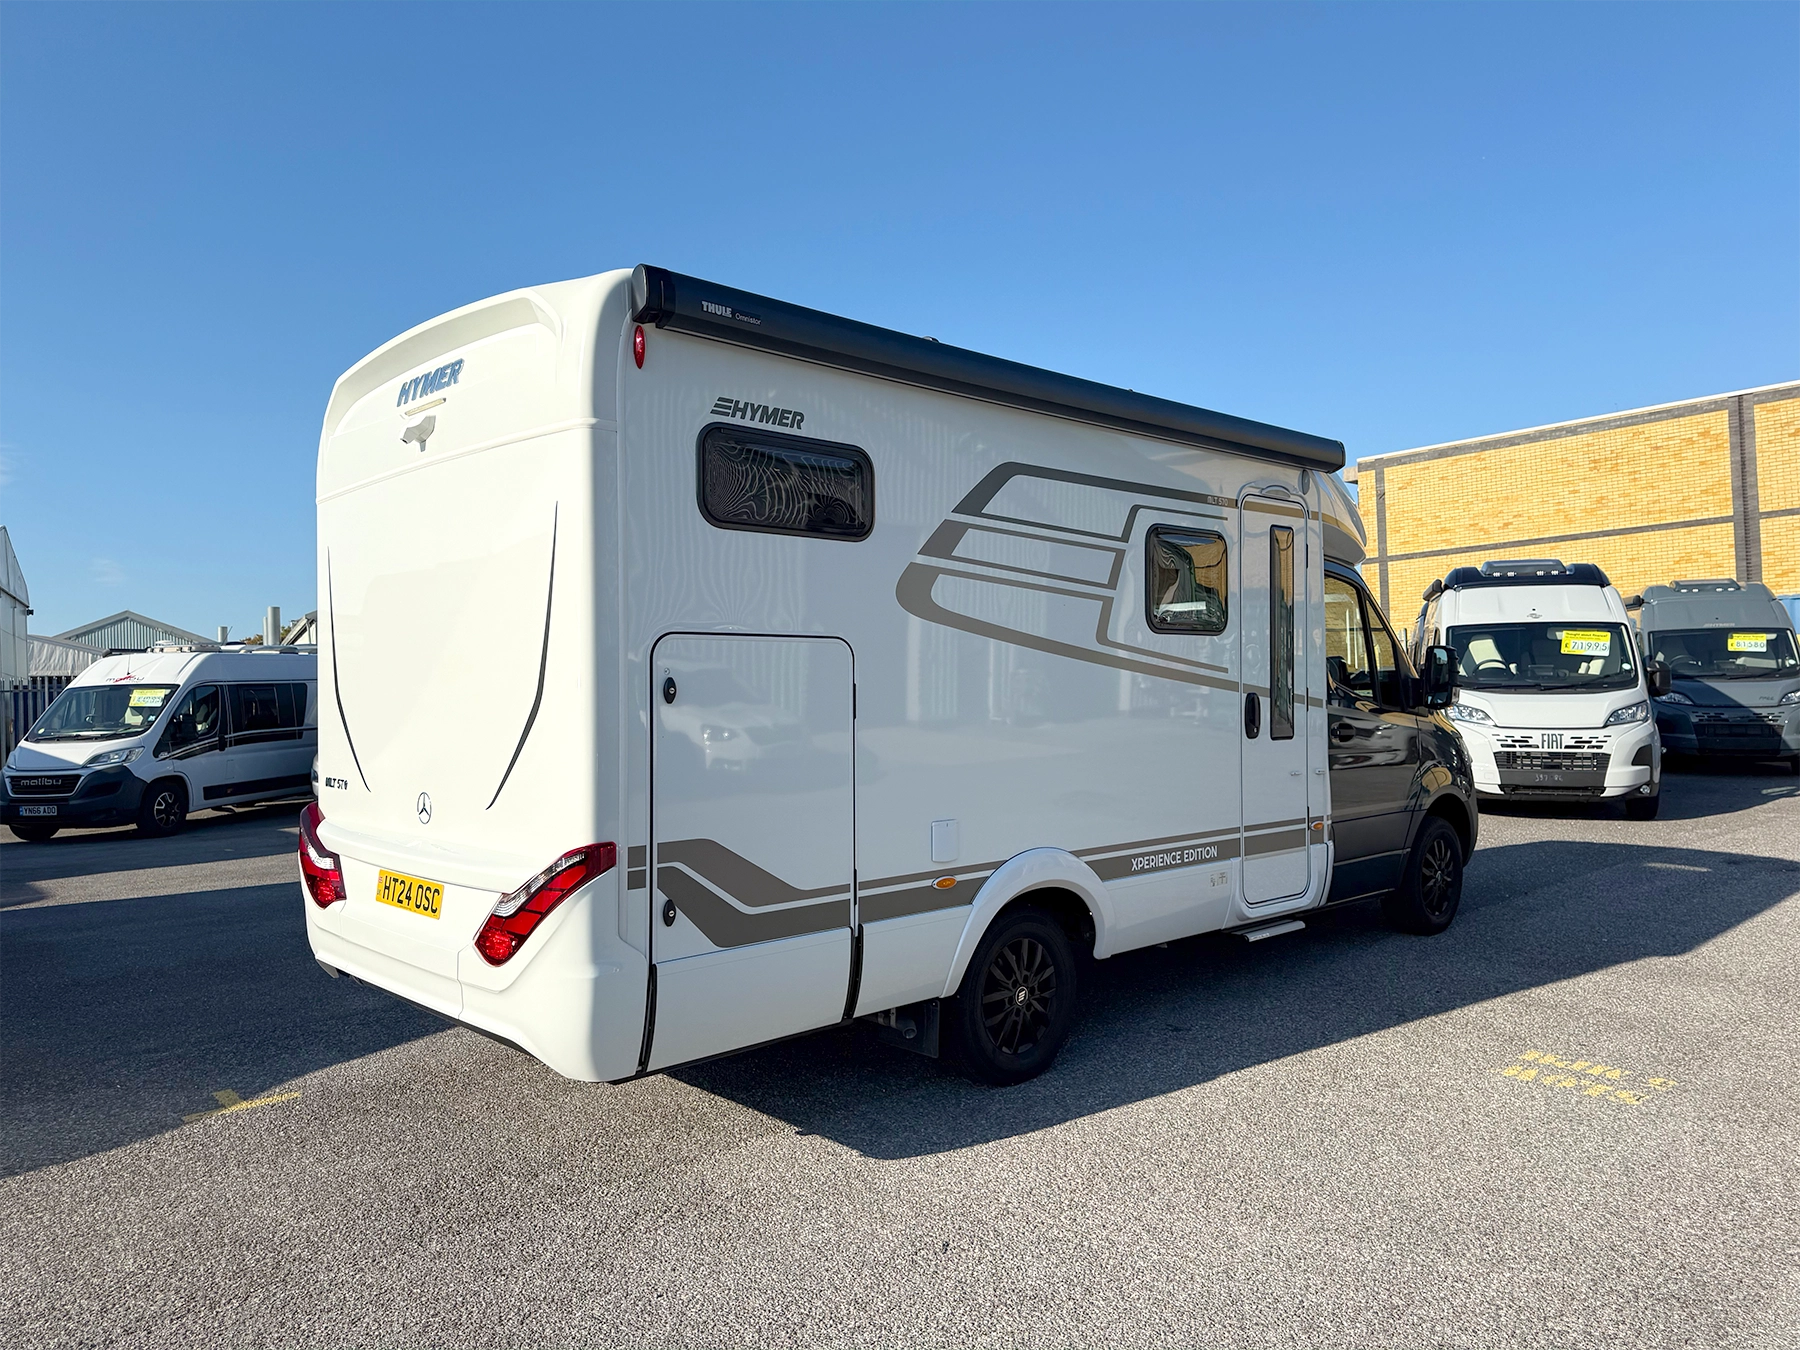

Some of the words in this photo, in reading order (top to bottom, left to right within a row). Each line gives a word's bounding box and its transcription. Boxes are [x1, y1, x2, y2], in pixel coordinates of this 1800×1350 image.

[701, 300, 732, 318] THULE
[735, 312, 761, 325] Omnistor
[396, 358, 464, 407] HYMER
[730, 399, 805, 430] HYMER
[1541, 733, 1565, 750] FIAT
[20, 778, 62, 786] malibu
[23, 806, 42, 815] YN66
[1131, 852, 1182, 871] XPERIENCE
[1184, 845, 1218, 862] EDITION
[382, 875, 413, 907] HT24
[414, 884, 440, 914] OSC
